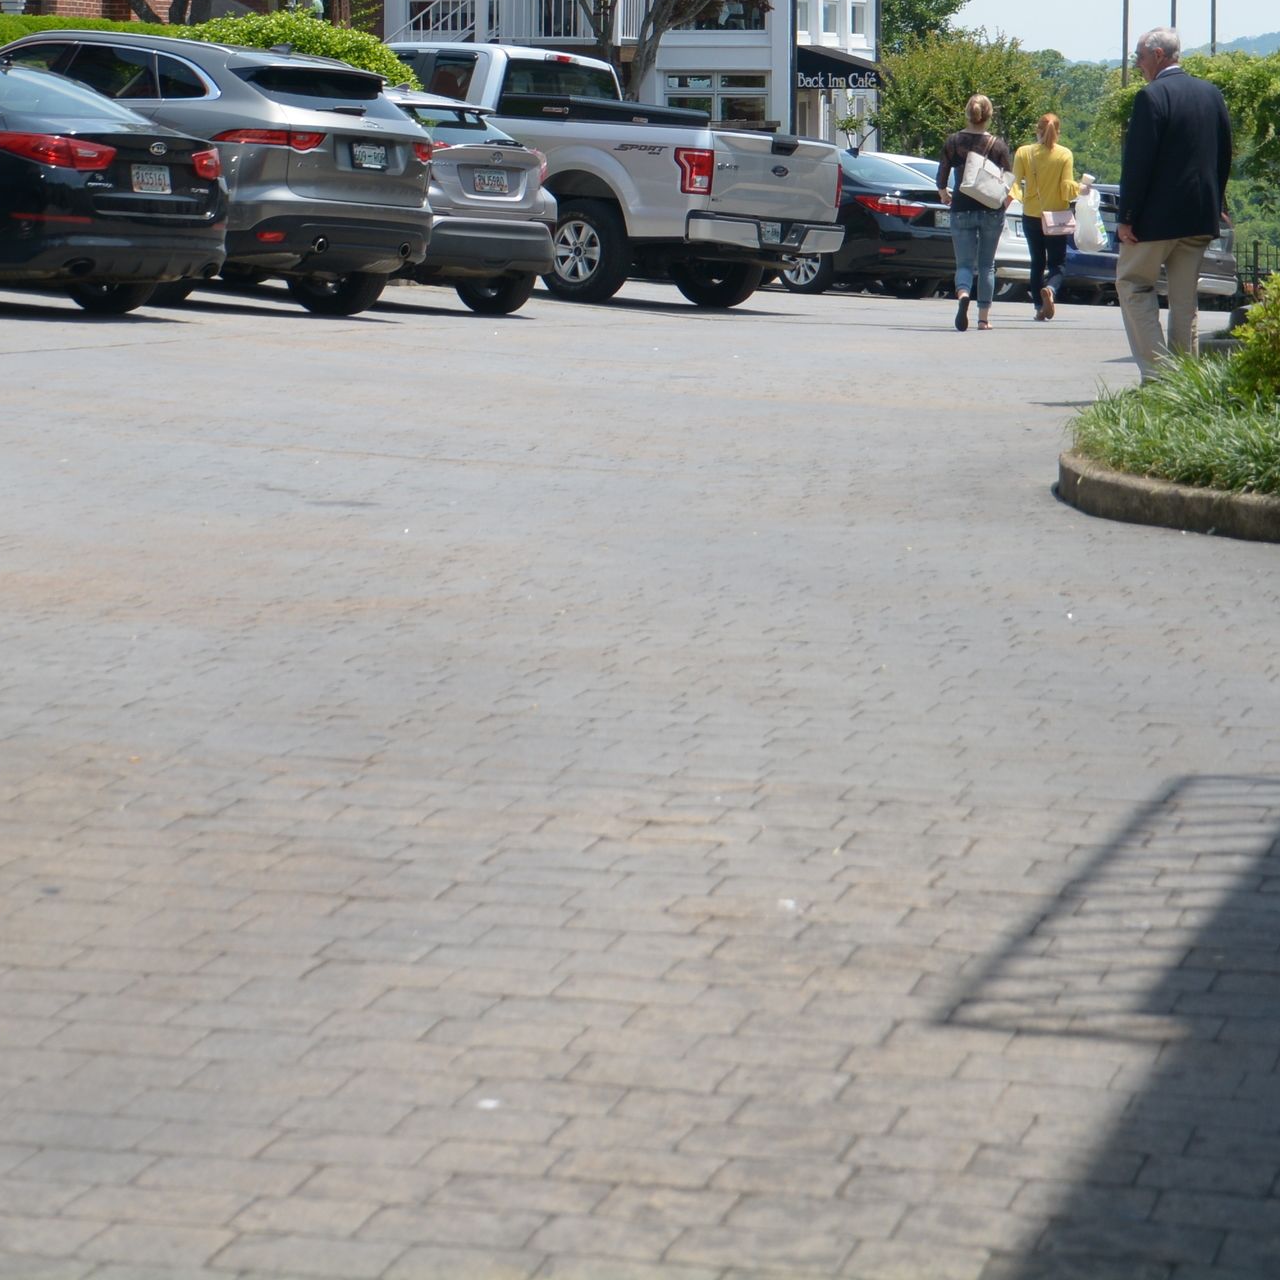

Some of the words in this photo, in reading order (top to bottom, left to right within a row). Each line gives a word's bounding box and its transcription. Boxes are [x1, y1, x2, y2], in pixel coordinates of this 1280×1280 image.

[797, 72, 825, 88] Back
[827, 73, 847, 88] Inn
[848, 72, 877, 88] Café
[613, 143, 669, 152] SPORT
